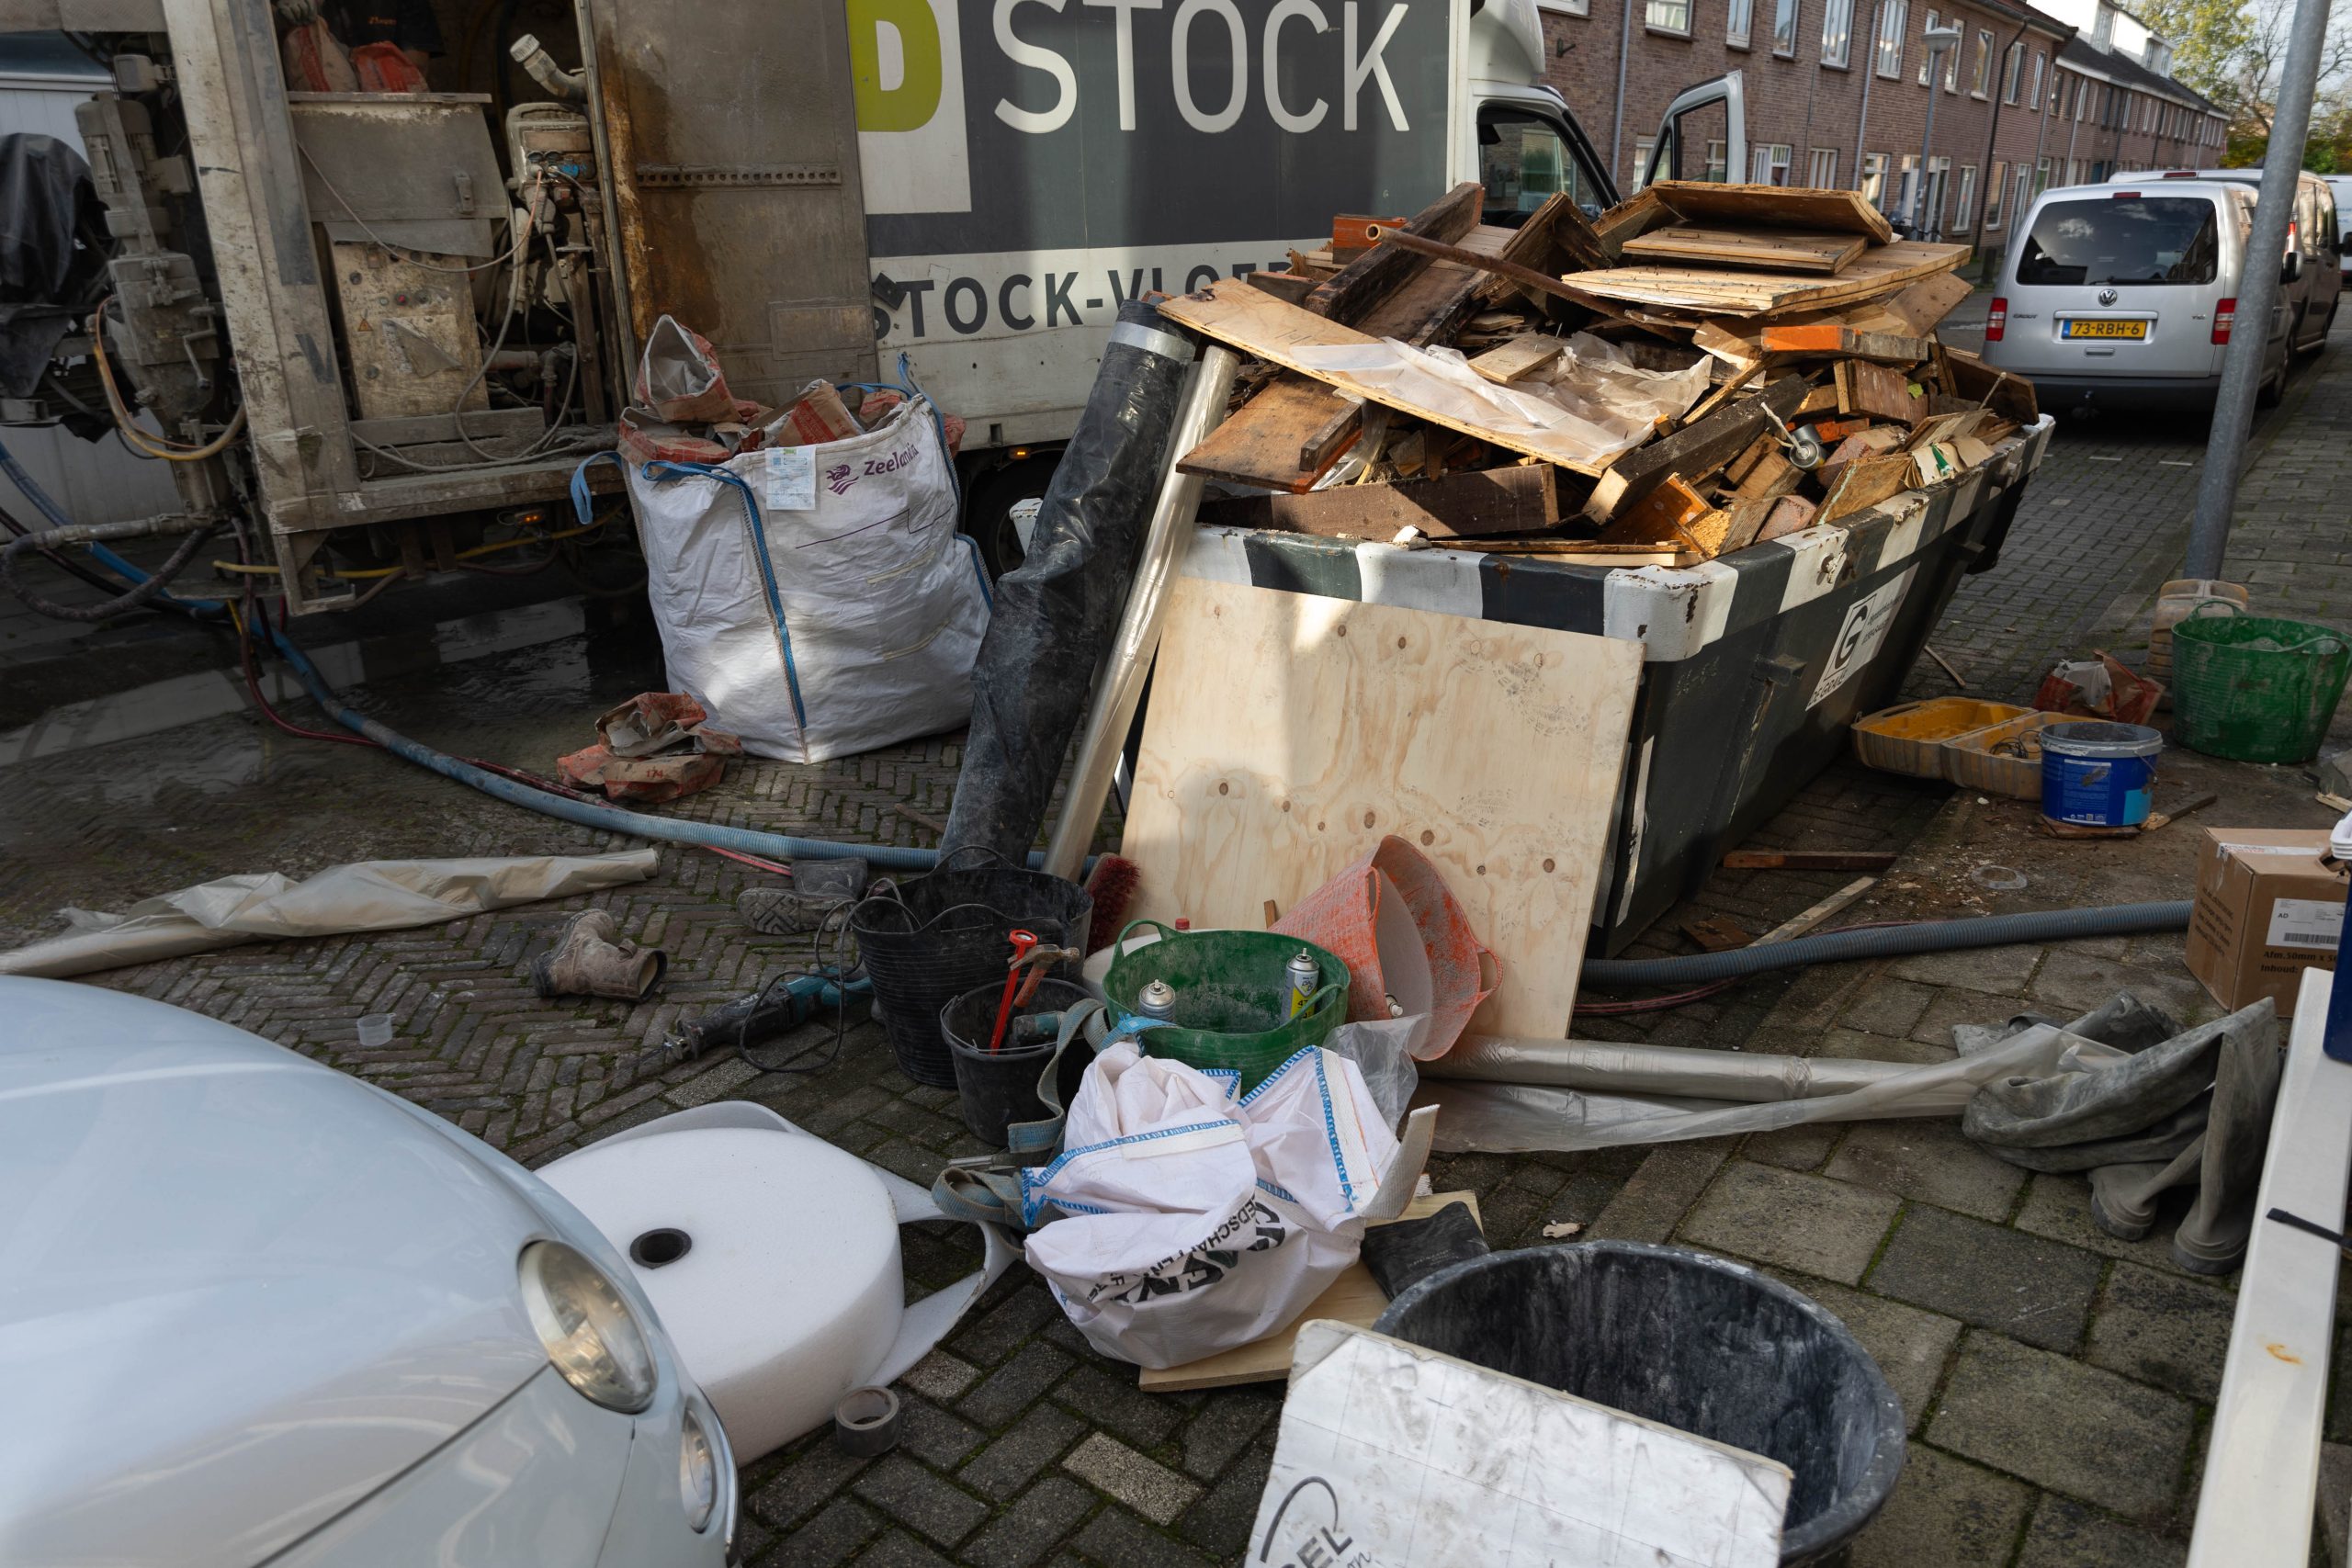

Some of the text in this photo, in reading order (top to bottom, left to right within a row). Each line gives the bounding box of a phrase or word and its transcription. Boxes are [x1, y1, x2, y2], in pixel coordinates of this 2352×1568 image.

[993, 0, 1410, 133] STOCK
[2074, 322, 2140, 335] 73-RBH-6
[1835, 604, 1869, 670] G
[2260, 964, 2298, 975] Inhoud:
